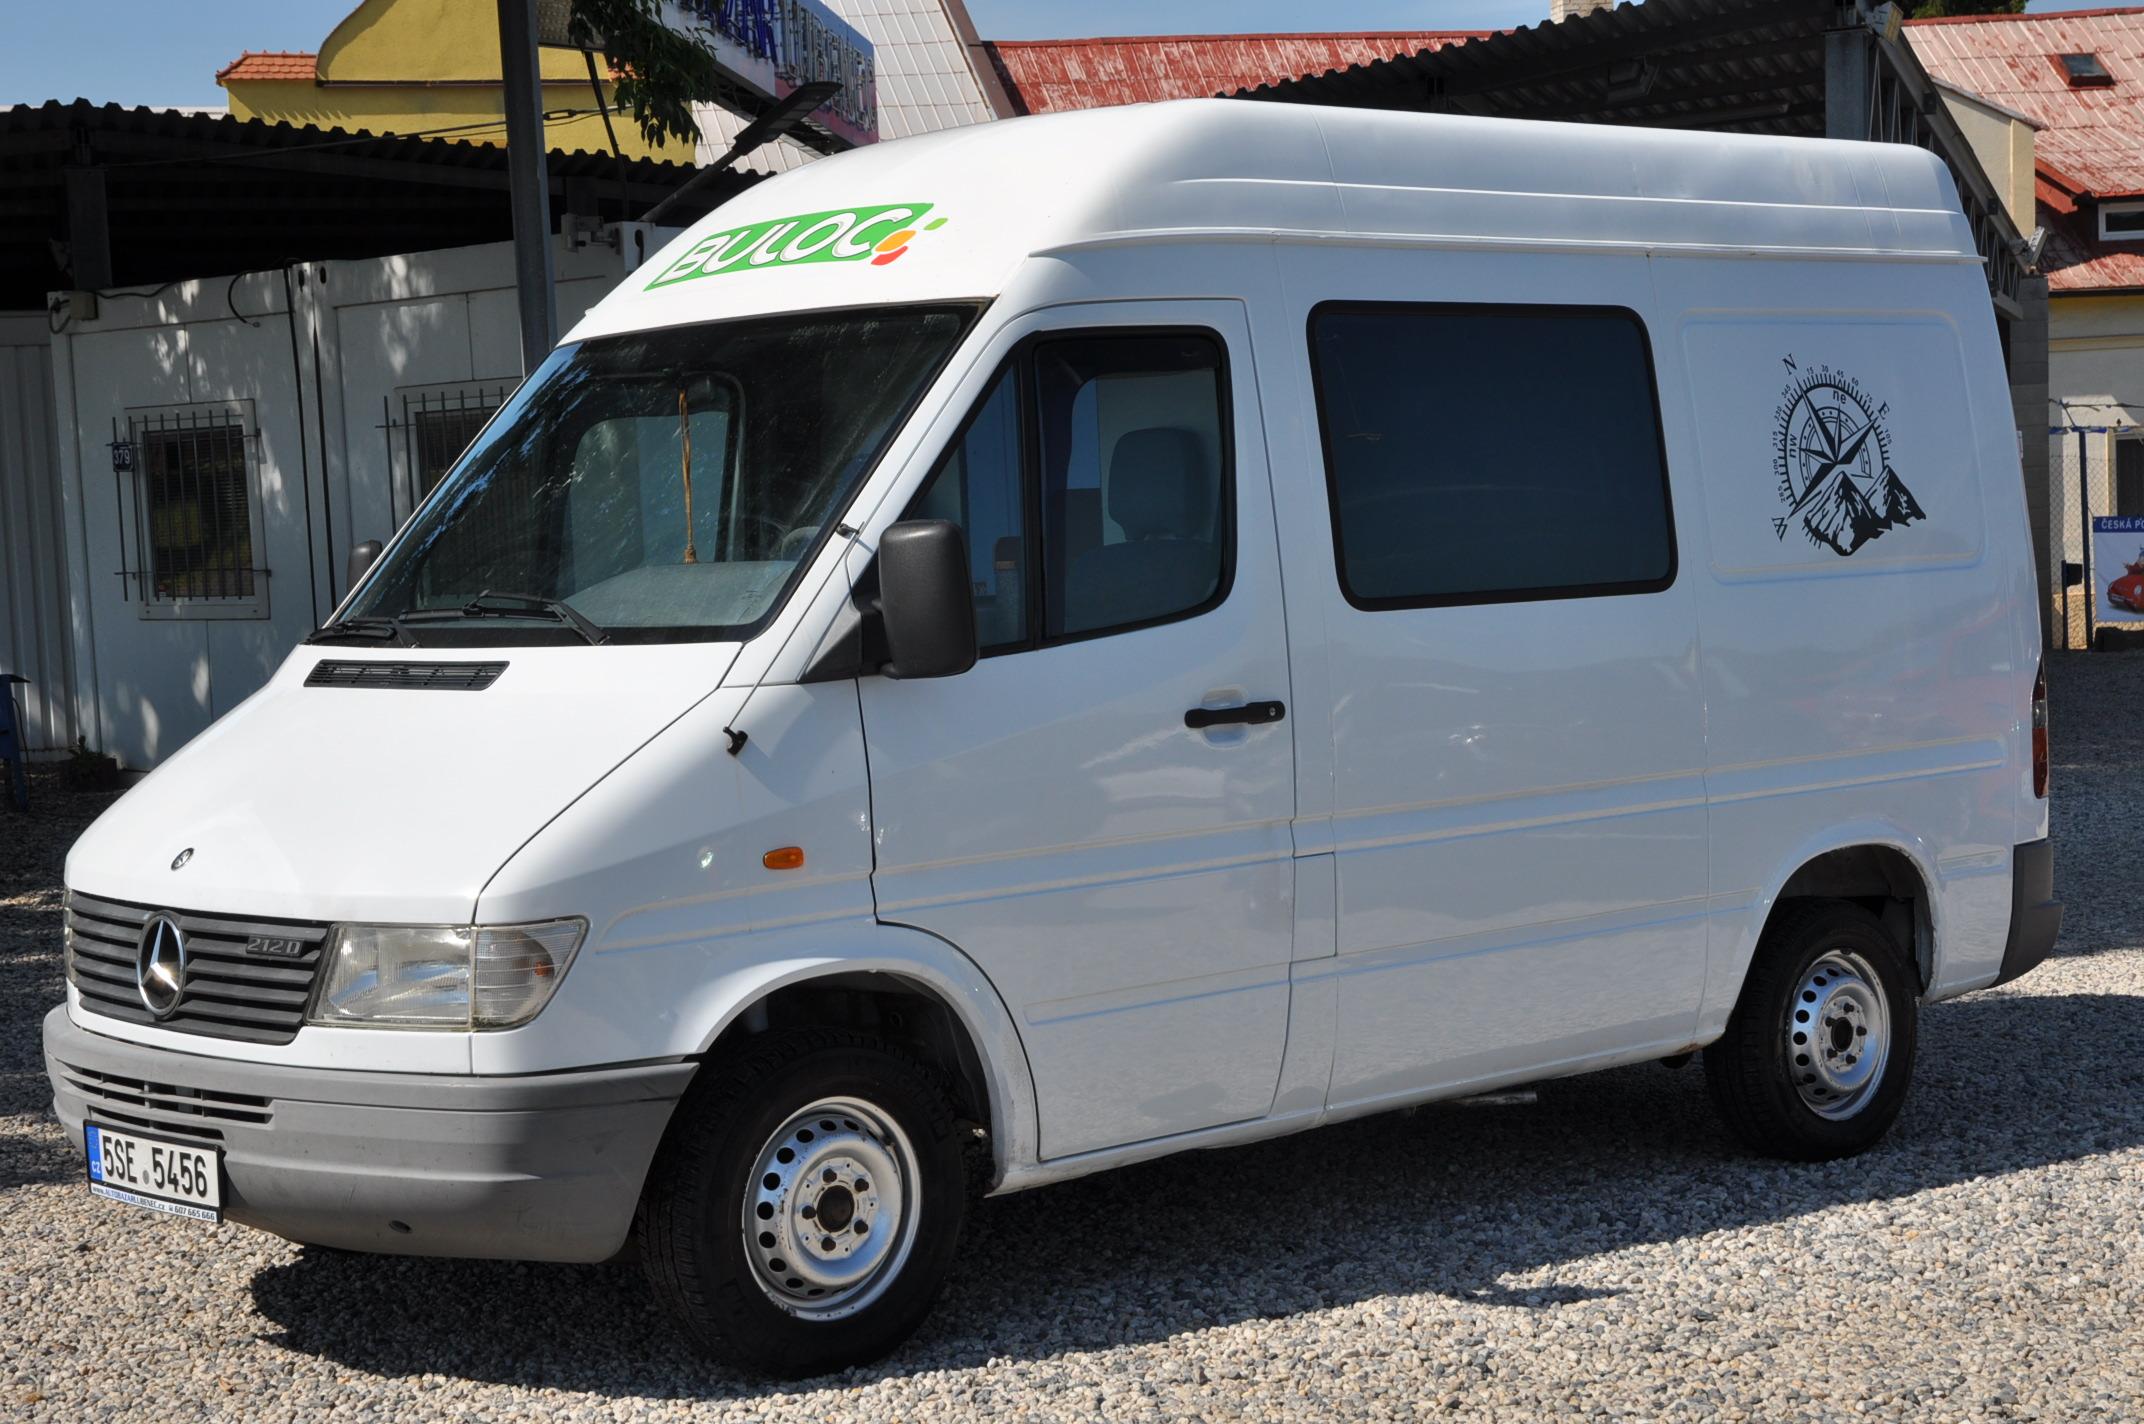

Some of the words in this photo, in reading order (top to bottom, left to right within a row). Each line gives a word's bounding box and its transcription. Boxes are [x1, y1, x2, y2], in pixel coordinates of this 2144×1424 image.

[653, 208, 913, 286] BULOC
[1781, 353, 1798, 376] N
[1806, 366, 1815, 375] 15
[1832, 390, 1847, 405] ne
[1878, 400, 1891, 420] E
[113, 449, 131, 465] 379
[2101, 517, 2132, 530] ČESKÁ
[91, 1161, 101, 1174] CZ
[102, 1135, 138, 1184] 5SE
[152, 1147, 208, 1198] 5456
[174, 1206, 187, 1215] 607
